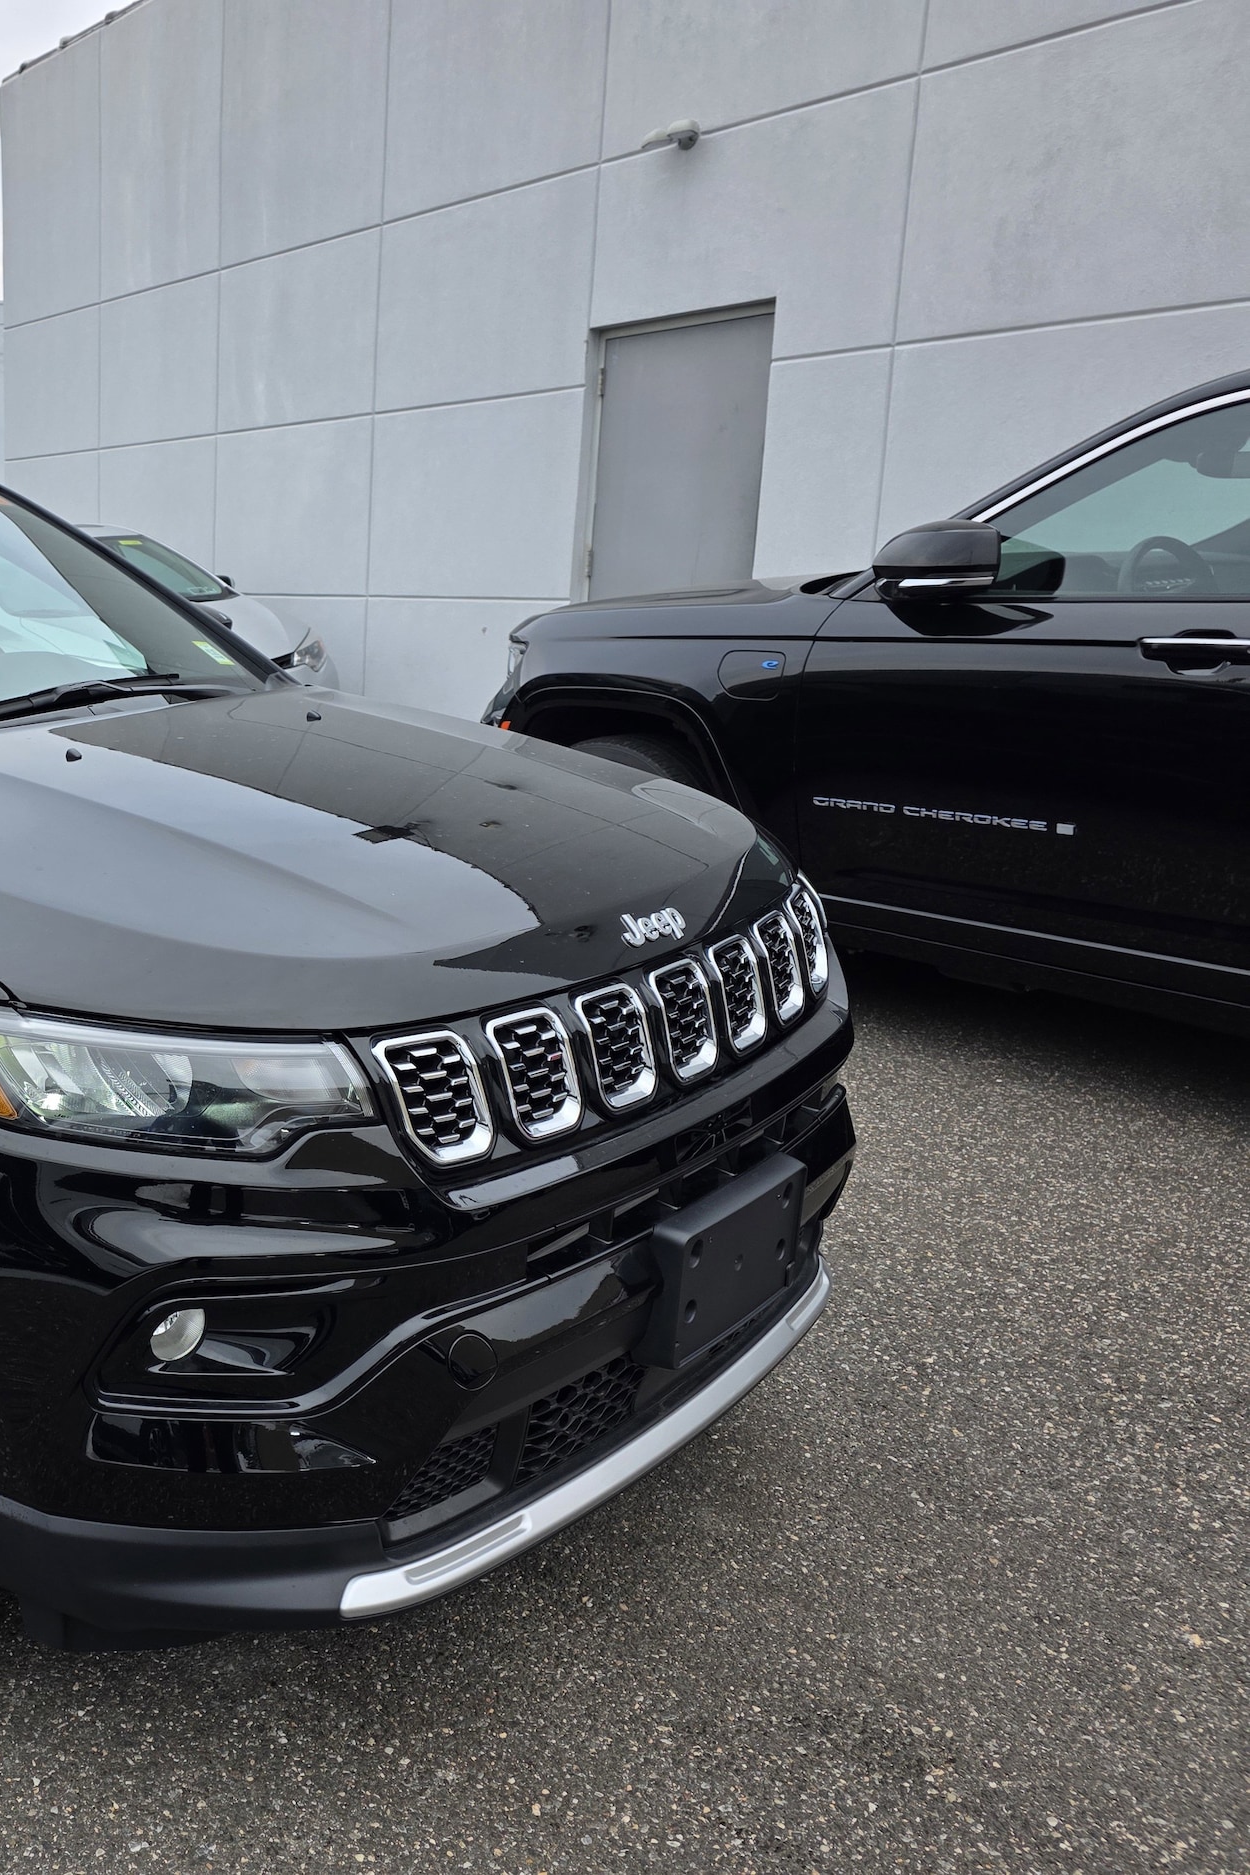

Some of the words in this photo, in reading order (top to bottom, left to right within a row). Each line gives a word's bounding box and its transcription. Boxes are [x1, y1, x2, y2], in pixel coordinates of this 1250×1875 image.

[812, 796, 895, 814] GRAND
[903, 806, 1048, 832] CHEROKEE
[619, 907, 687, 948] Jeep
